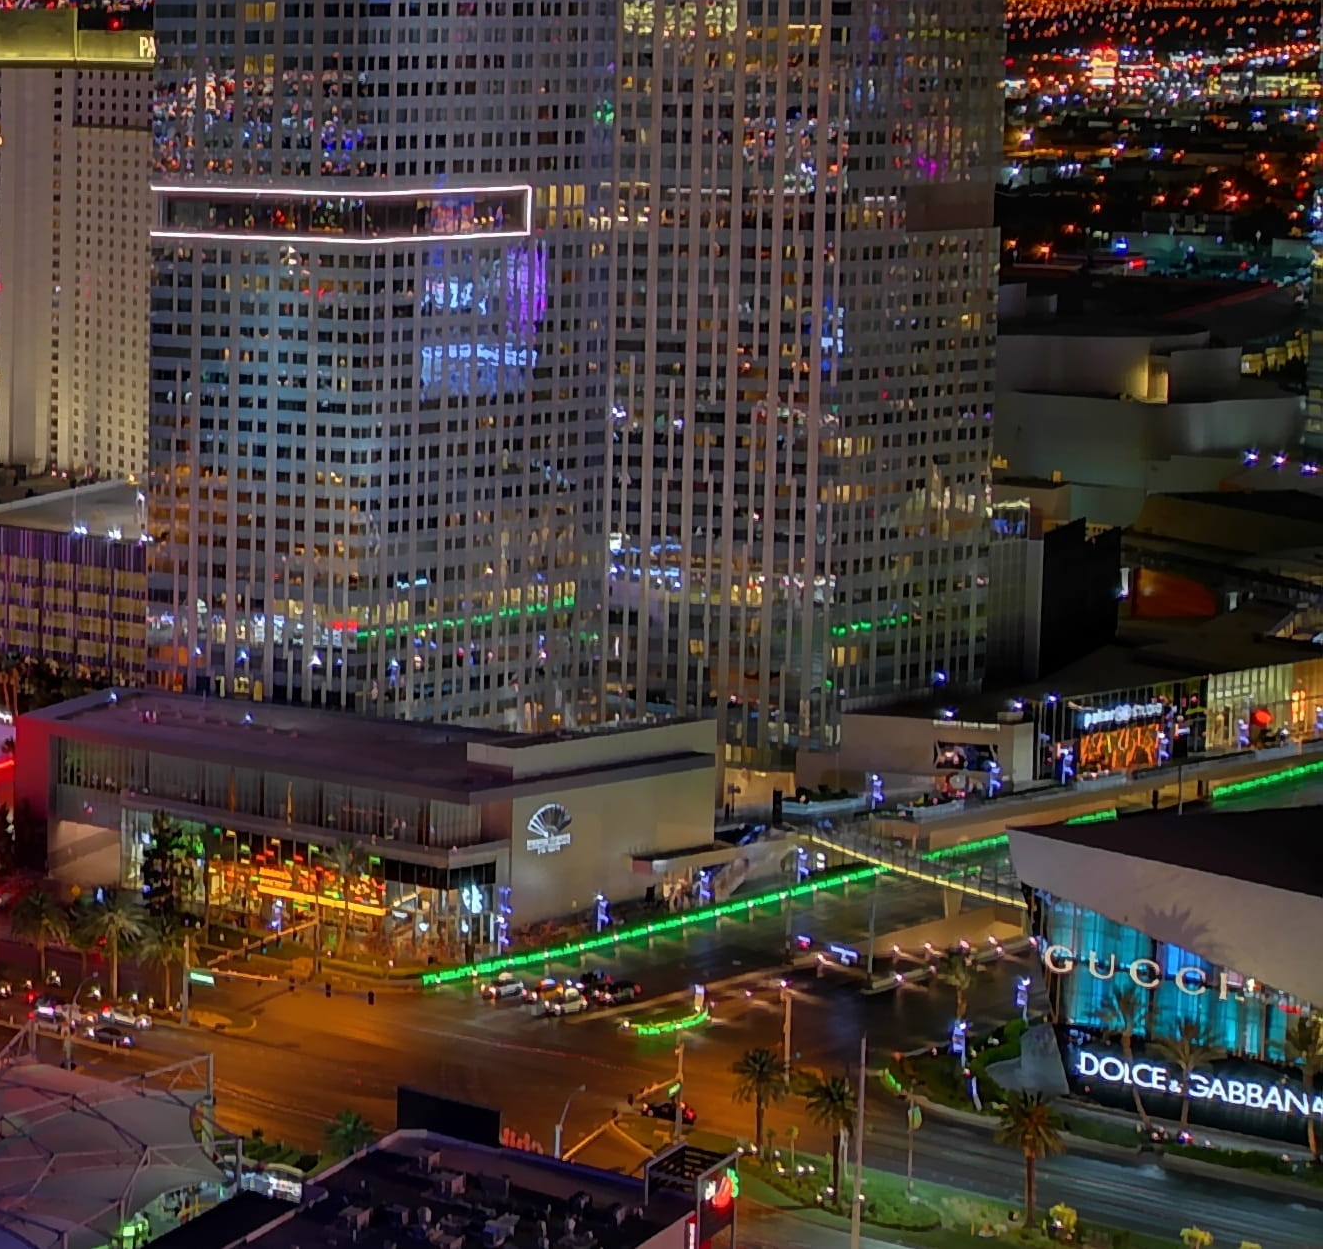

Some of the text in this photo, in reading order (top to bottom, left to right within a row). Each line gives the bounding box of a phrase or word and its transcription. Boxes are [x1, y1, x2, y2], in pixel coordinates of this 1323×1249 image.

[139, 35, 157, 58] PA
[1044, 944, 1229, 1002] GUCCI
[1077, 1051, 1168, 1092] DOLCE
